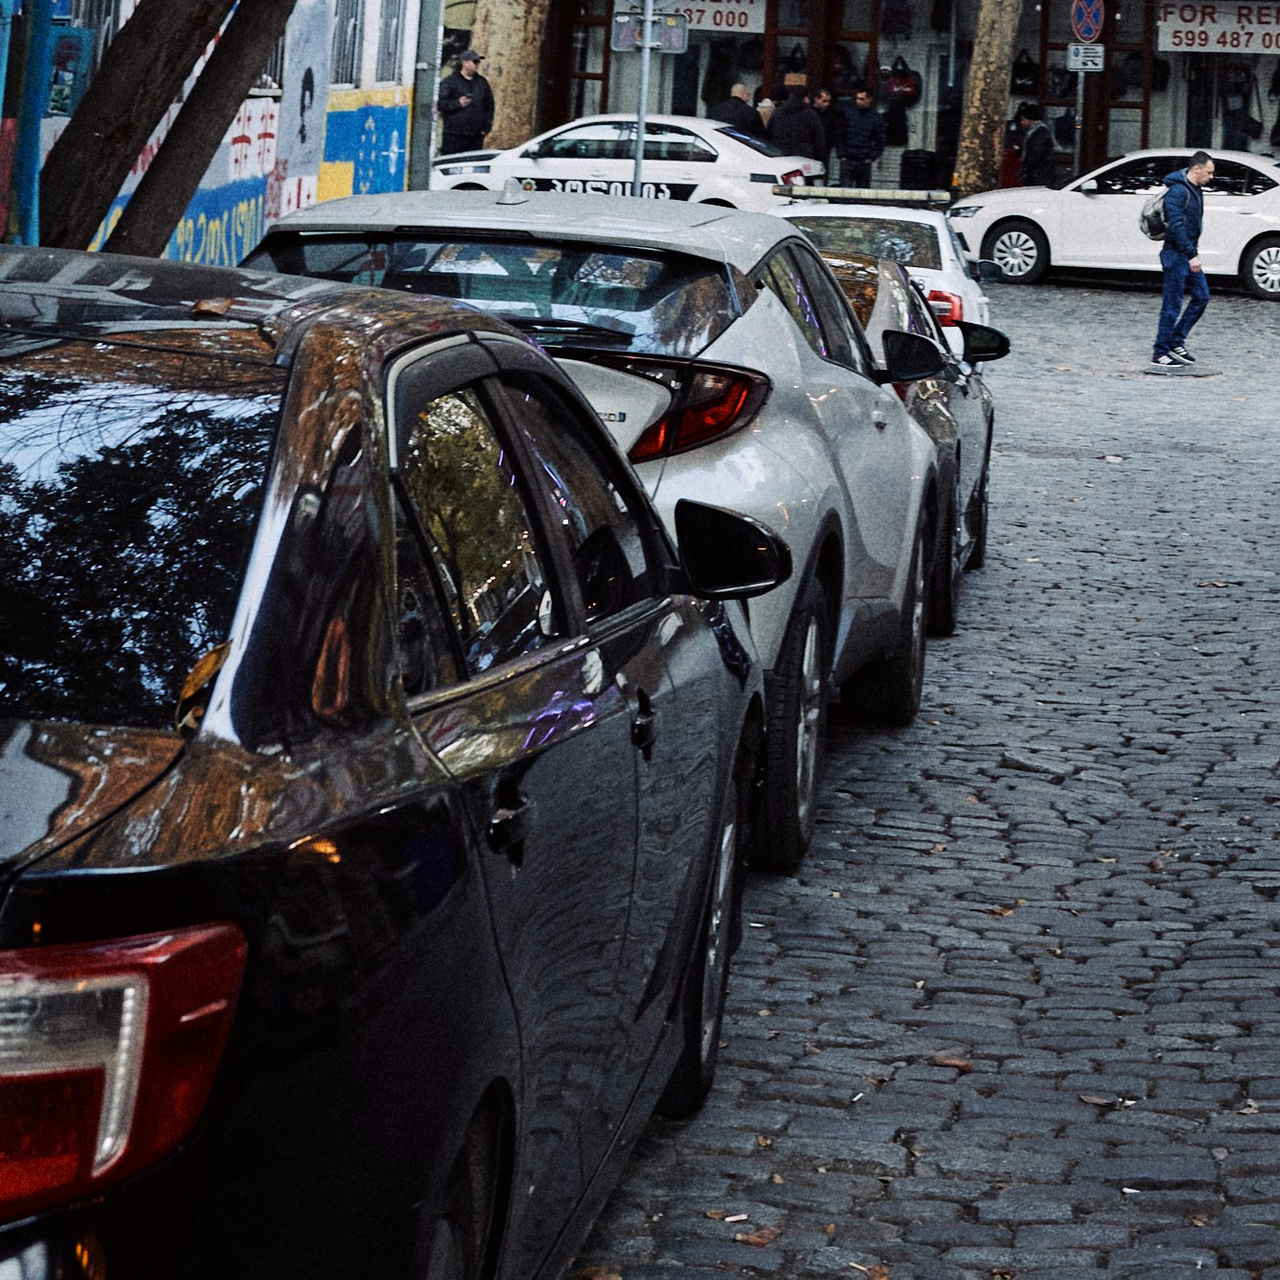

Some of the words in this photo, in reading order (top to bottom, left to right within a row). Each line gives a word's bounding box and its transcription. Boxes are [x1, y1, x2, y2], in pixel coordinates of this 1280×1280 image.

[712, 9, 749, 28] 000
[1161, 3, 1217, 24] FOR
[1172, 30, 1209, 47] 599
[1216, 31, 1254, 48] 487
